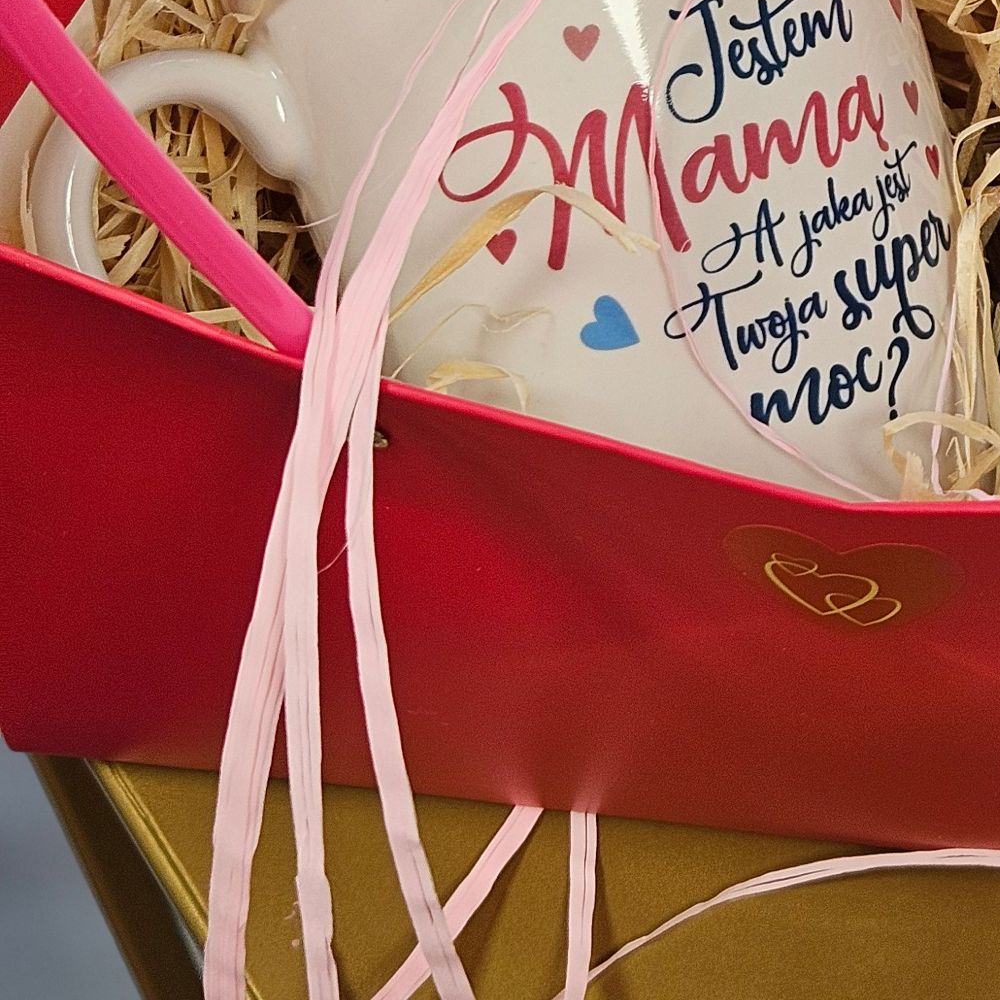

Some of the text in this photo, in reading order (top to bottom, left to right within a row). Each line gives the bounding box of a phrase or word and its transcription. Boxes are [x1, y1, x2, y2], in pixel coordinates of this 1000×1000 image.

[438, 74, 889, 270] Mamą
[701, 141, 918, 277] A jaka jest
[664, 209, 951, 374] Twoja super
[751, 336, 910, 425] moc?
